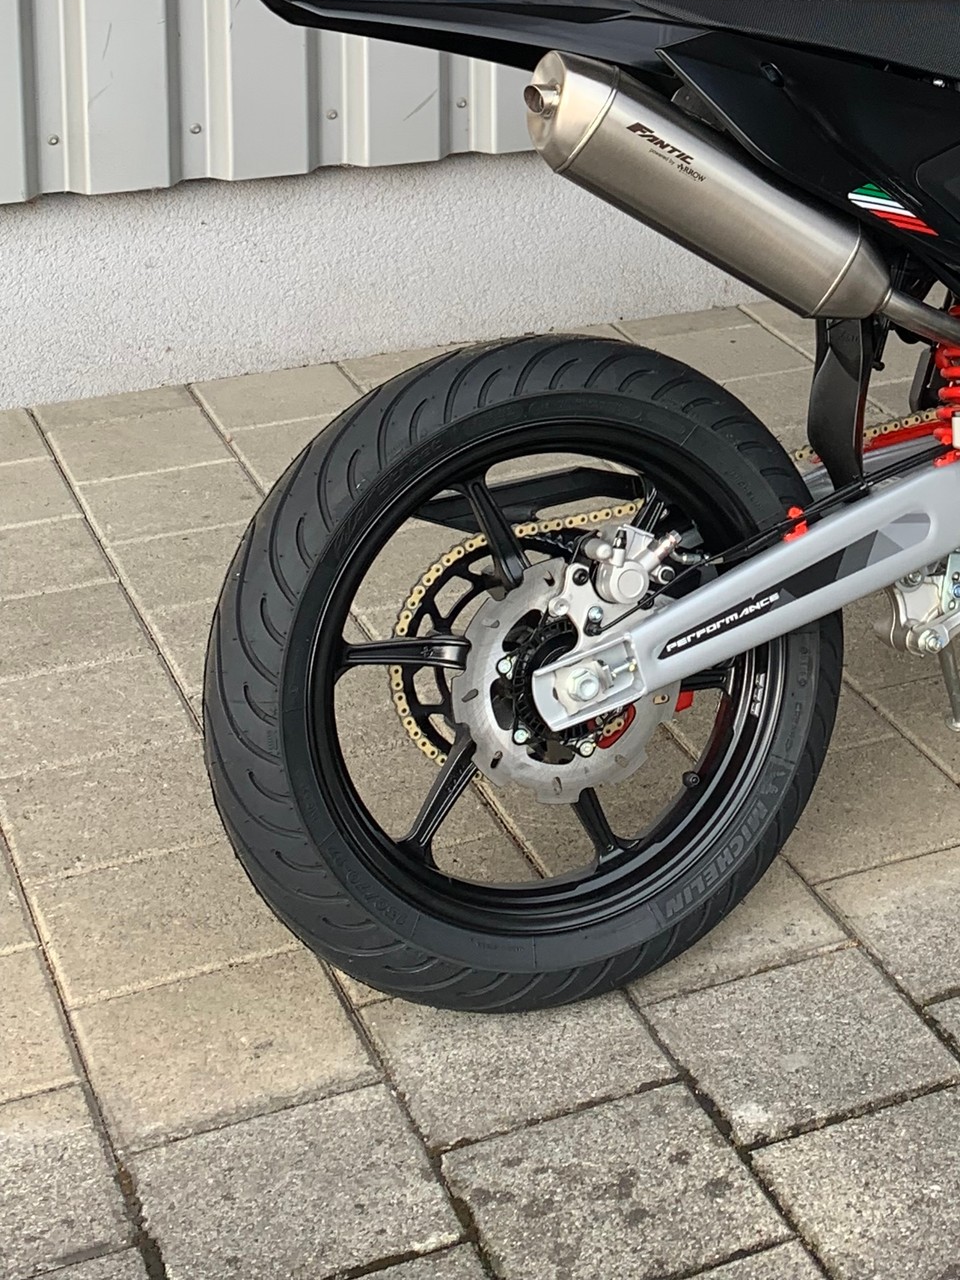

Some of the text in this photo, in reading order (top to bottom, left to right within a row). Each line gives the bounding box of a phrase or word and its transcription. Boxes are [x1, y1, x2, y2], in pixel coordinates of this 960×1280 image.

[626, 122, 694, 165] FANTIC
[677, 163, 706, 182] ARROW
[664, 800, 769, 918] MICHELIN
